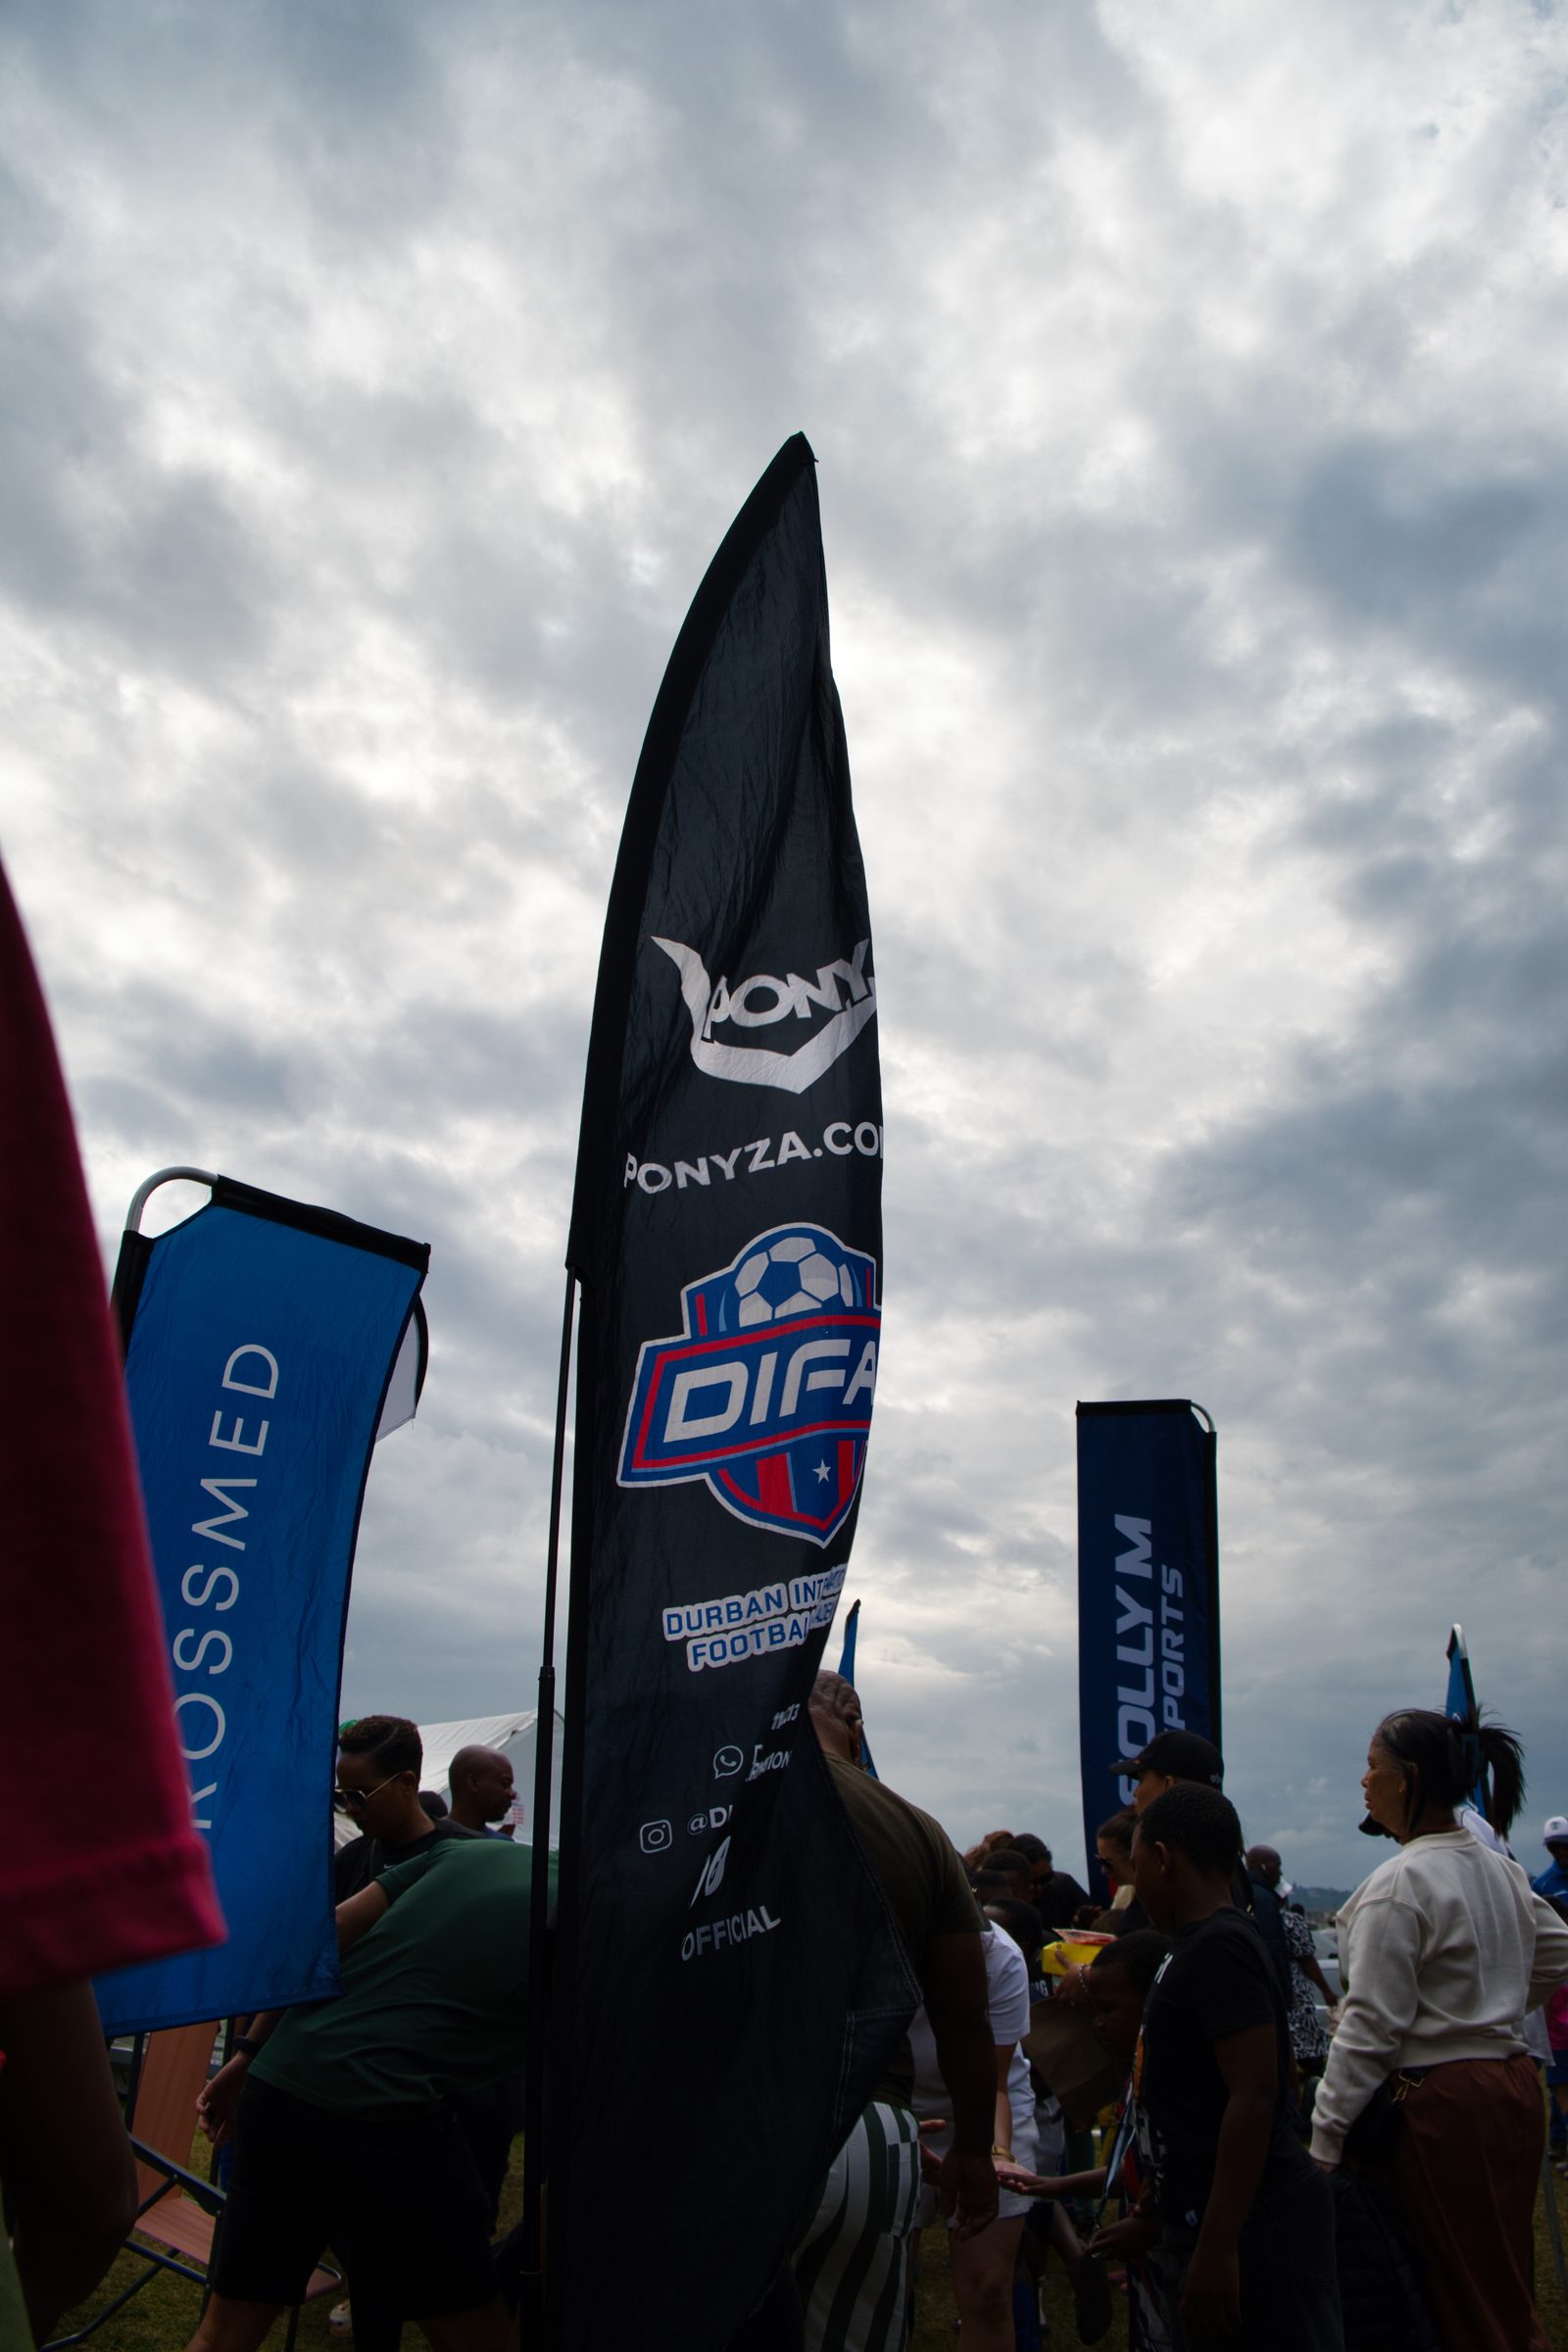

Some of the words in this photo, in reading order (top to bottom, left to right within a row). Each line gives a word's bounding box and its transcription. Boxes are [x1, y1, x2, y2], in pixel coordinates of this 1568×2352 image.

[623, 1121, 883, 1194] PONYZA.CO
[663, 1338, 877, 1444] DIFA
[1113, 1512, 1153, 1580] M
[666, 1588, 783, 1636] DURBAN
[680, 1905, 782, 1962] OFFICIAL
